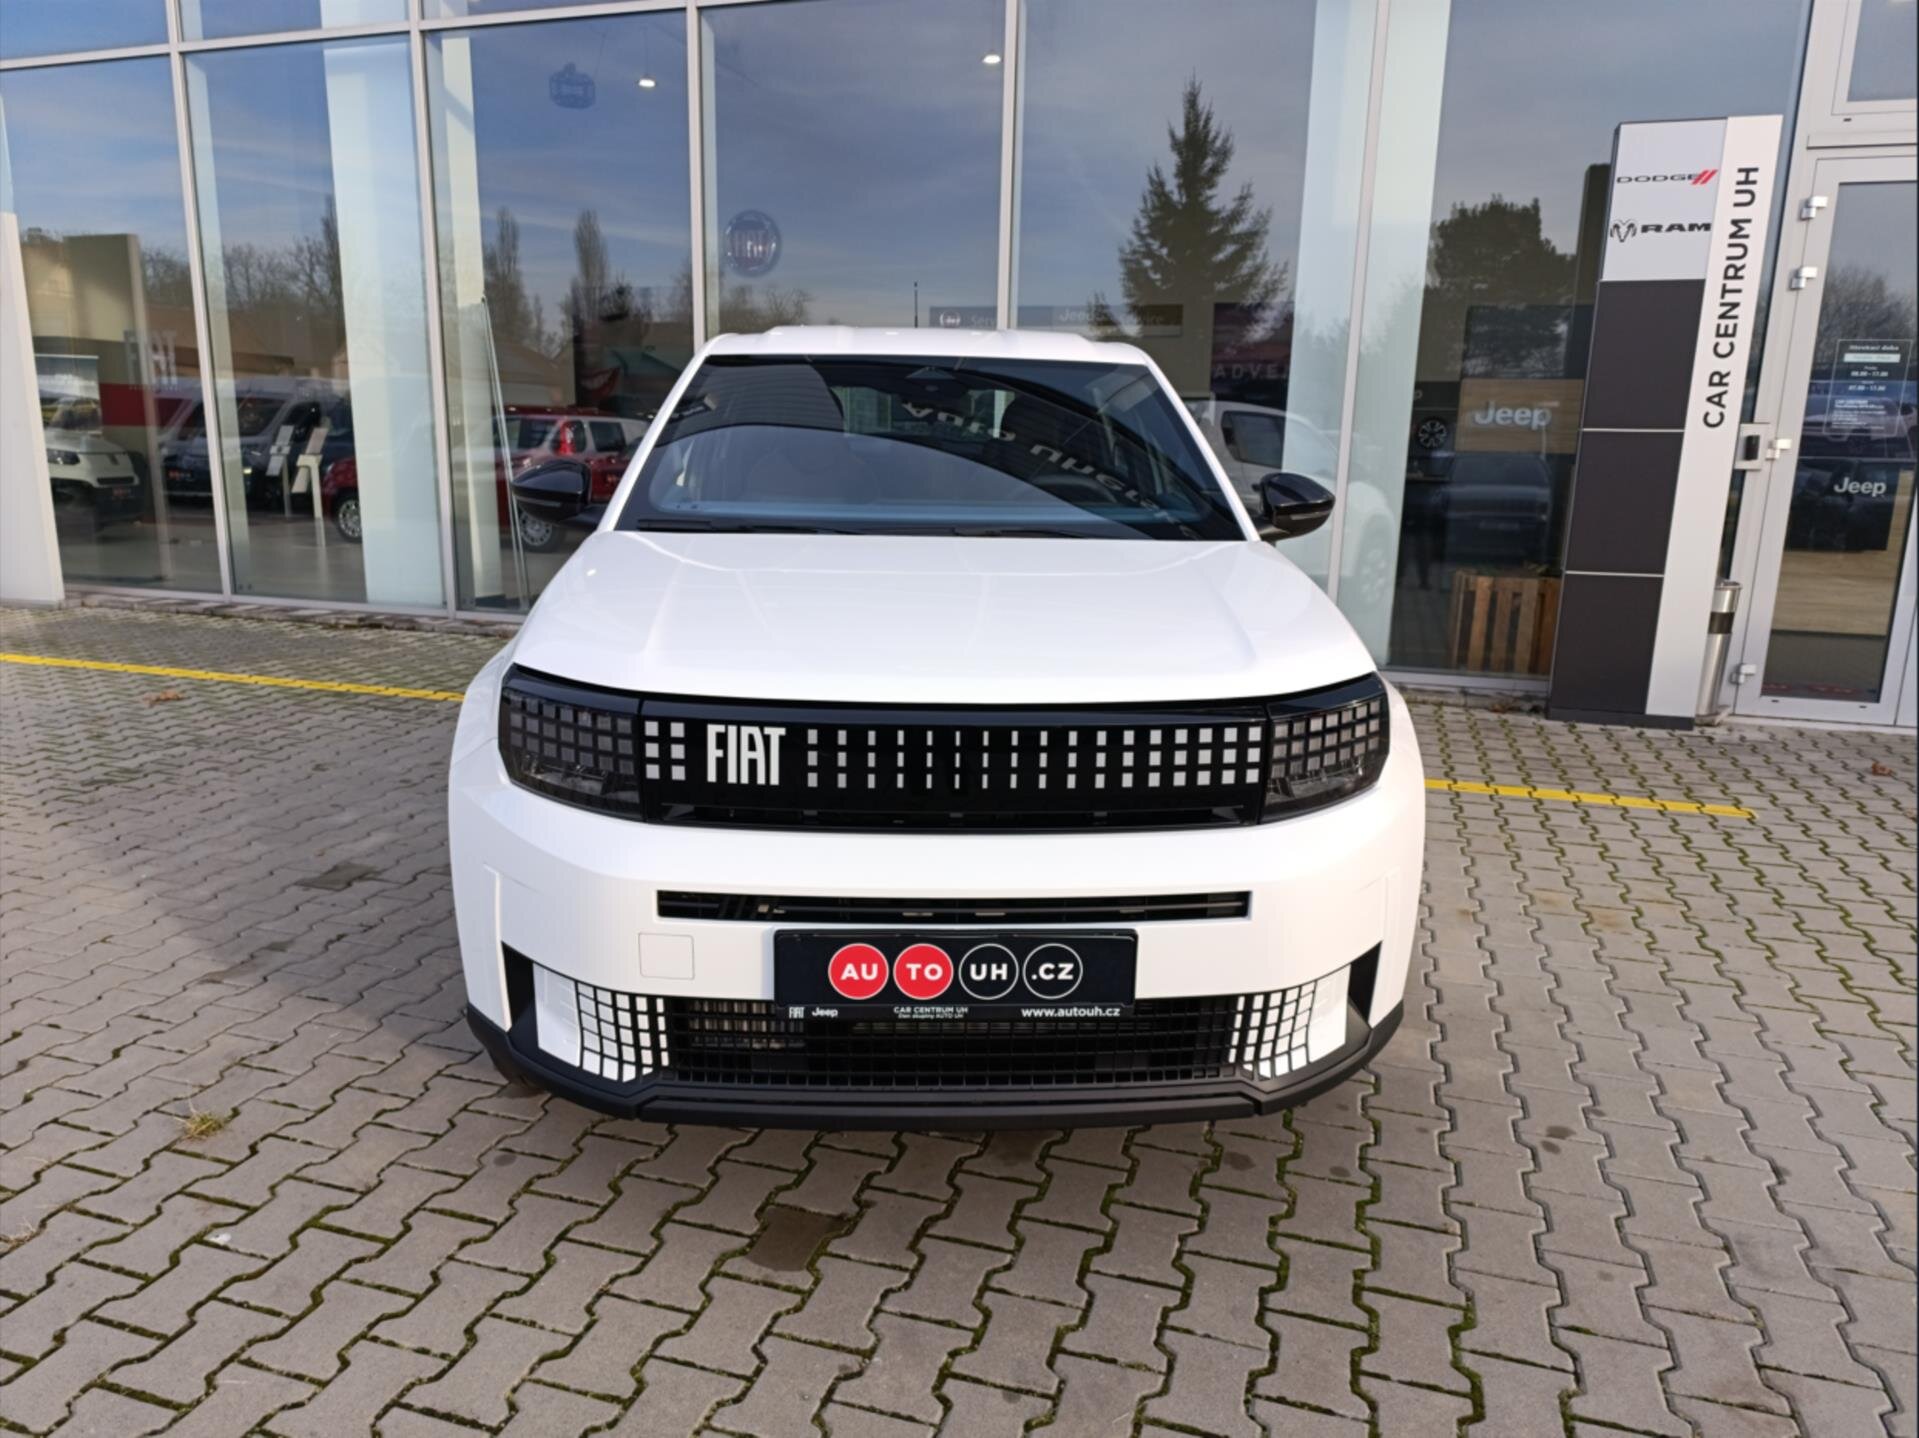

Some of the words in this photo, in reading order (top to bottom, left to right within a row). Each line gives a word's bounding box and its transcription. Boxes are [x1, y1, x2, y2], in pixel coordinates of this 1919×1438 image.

[1616, 174, 1698, 184] DODGE
[1733, 167, 1759, 207] UH
[1641, 222, 1712, 233] RAM
[1713, 218, 1752, 359] CENTRUM
[1213, 363, 1288, 379] ADVE
[1703, 370, 1731, 428] CAR
[1473, 401, 1552, 430] Jeep
[1833, 477, 1886, 497] Jeep
[707, 724, 786, 786] FIAT
[840, 963, 878, 981] AU
[906, 963, 943, 981] TO
[970, 963, 1008, 981] UH
[1031, 963, 1075, 980] .CZ
[812, 1006, 839, 1018] Jeep
[893, 1006, 911, 1014] CAR
[913, 1006, 954, 1014] CENTRUM
[1021, 1006, 1121, 1017] www.autouh.cz
